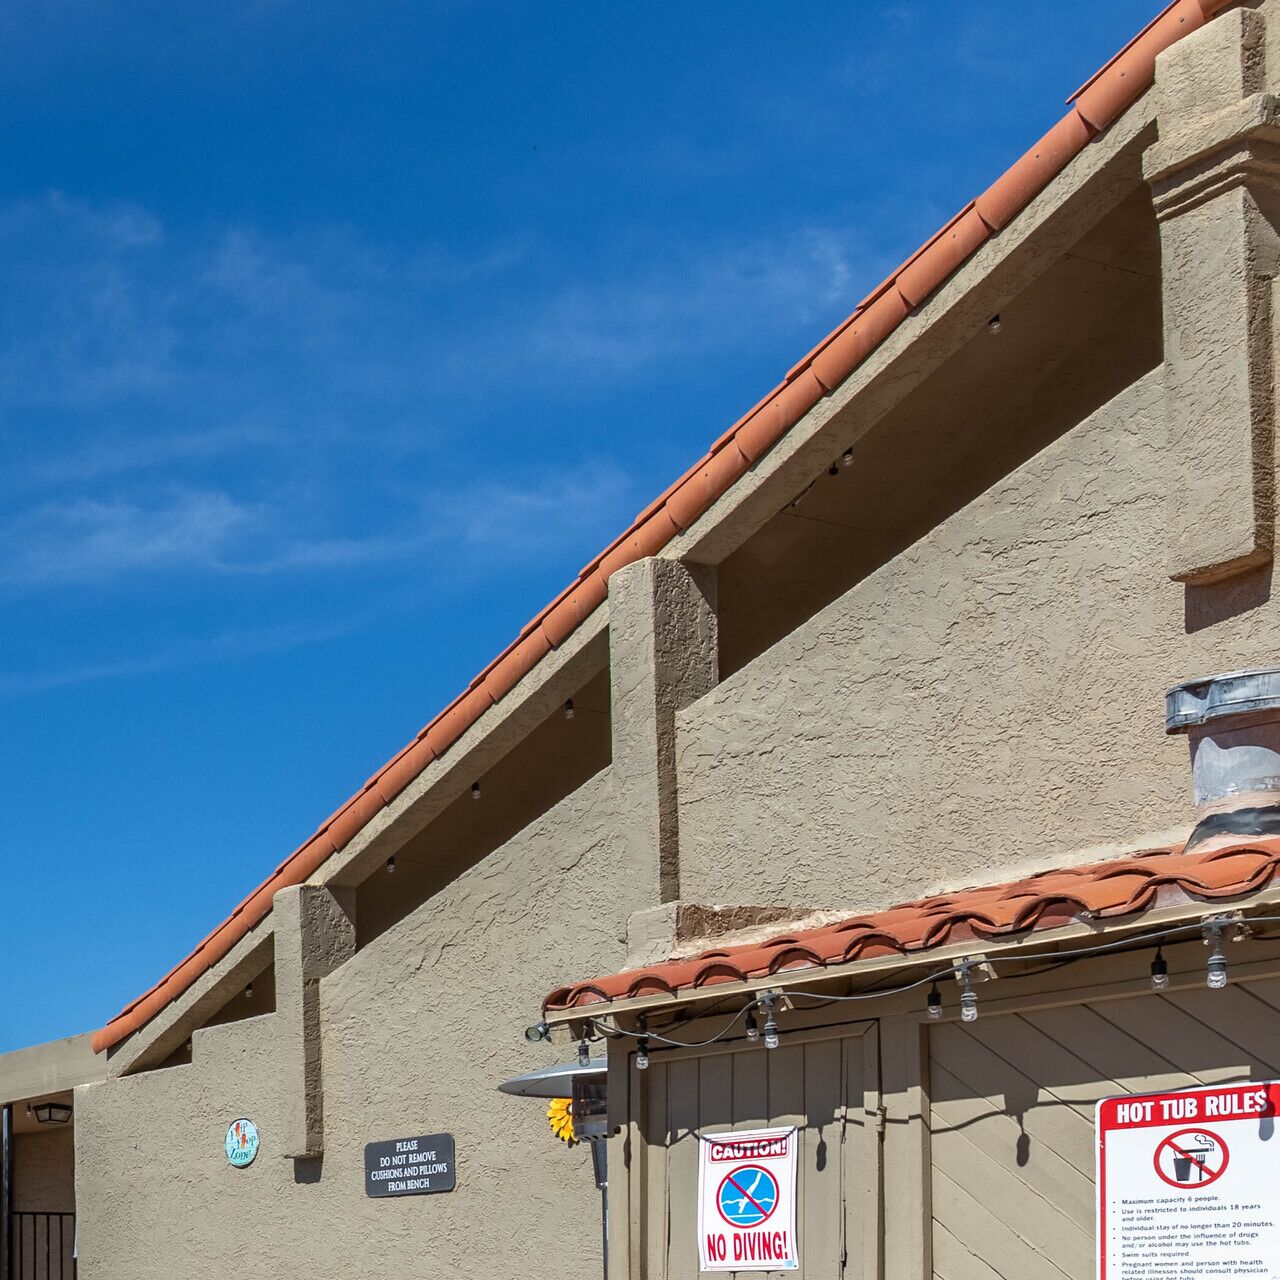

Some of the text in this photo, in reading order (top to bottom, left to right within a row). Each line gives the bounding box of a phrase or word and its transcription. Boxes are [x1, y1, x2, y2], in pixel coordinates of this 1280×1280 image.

[1117, 1089, 1268, 1124] HOT TUB RULES
[396, 1140, 418, 1152] PLEASE
[711, 1139, 787, 1160] CAUTION!
[380, 1151, 437, 1167] DO NOT REMOVE
[371, 1163, 448, 1180] CUSHIONS AND PILLOWS
[388, 1178, 430, 1191] FROM BENCH
[707, 1231, 789, 1262] NO DIVING!
[1234, 1267, 1269, 1275] physician
